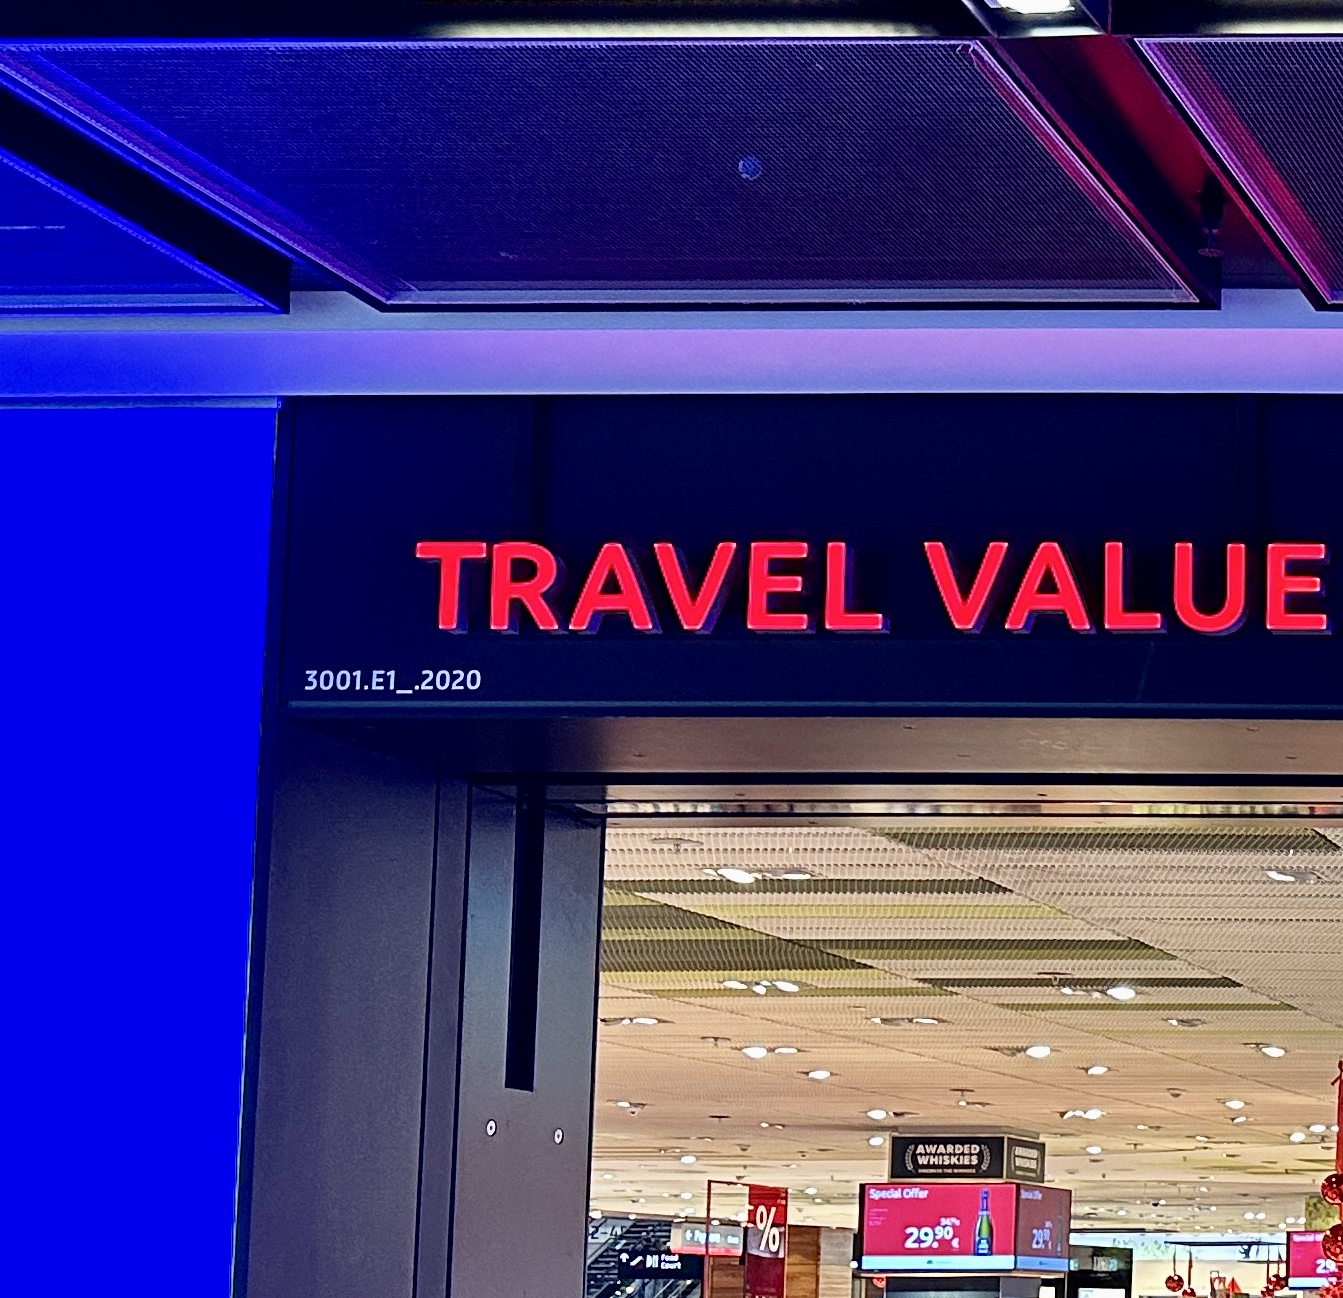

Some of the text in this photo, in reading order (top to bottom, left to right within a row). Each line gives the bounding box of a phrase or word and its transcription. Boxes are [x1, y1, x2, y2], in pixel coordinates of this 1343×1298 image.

[415, 541, 1328, 632] TRAVEL VALUE
[304, 669, 482, 694] 3001.E1_.2020
[915, 1144, 981, 1154] AWARDED
[917, 1155, 979, 1166] WHISKIES
